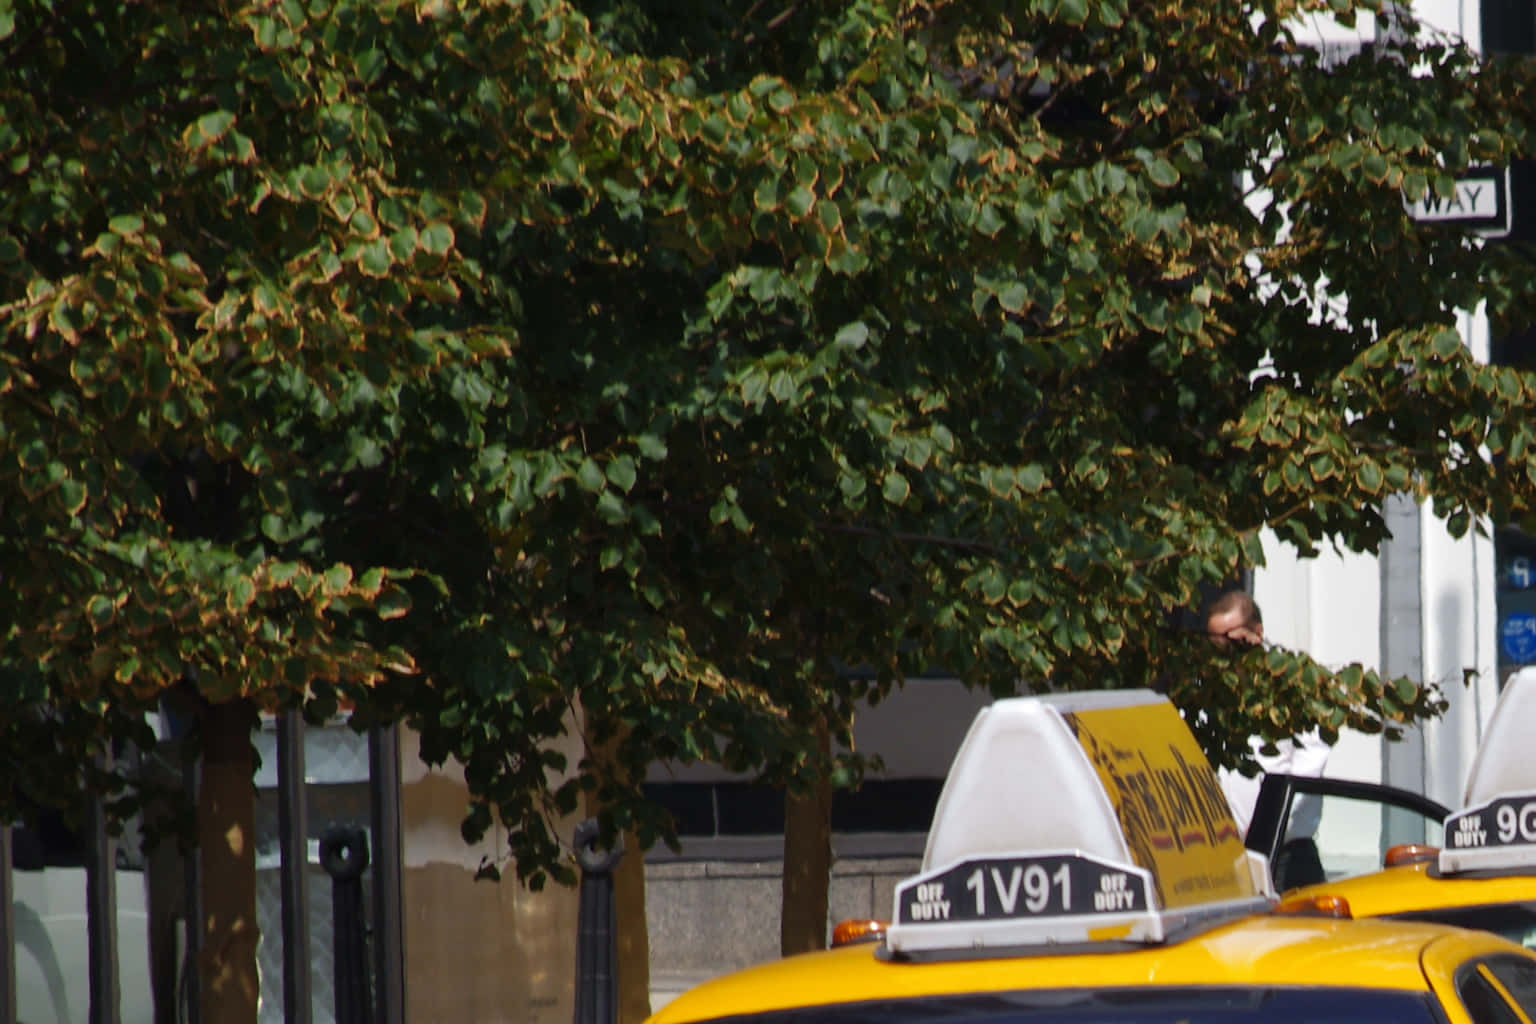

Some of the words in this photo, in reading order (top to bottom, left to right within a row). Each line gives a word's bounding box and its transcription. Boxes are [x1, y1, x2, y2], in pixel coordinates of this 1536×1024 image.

[1459, 815, 1481, 832] OFF
[1454, 830, 1487, 847] DUTY
[966, 863, 1072, 916] 1V91
[1100, 873, 1127, 892] OFF
[917, 883, 944, 902] OFF
[1094, 890, 1134, 911] DUTY
[910, 900, 950, 921] DUTY
